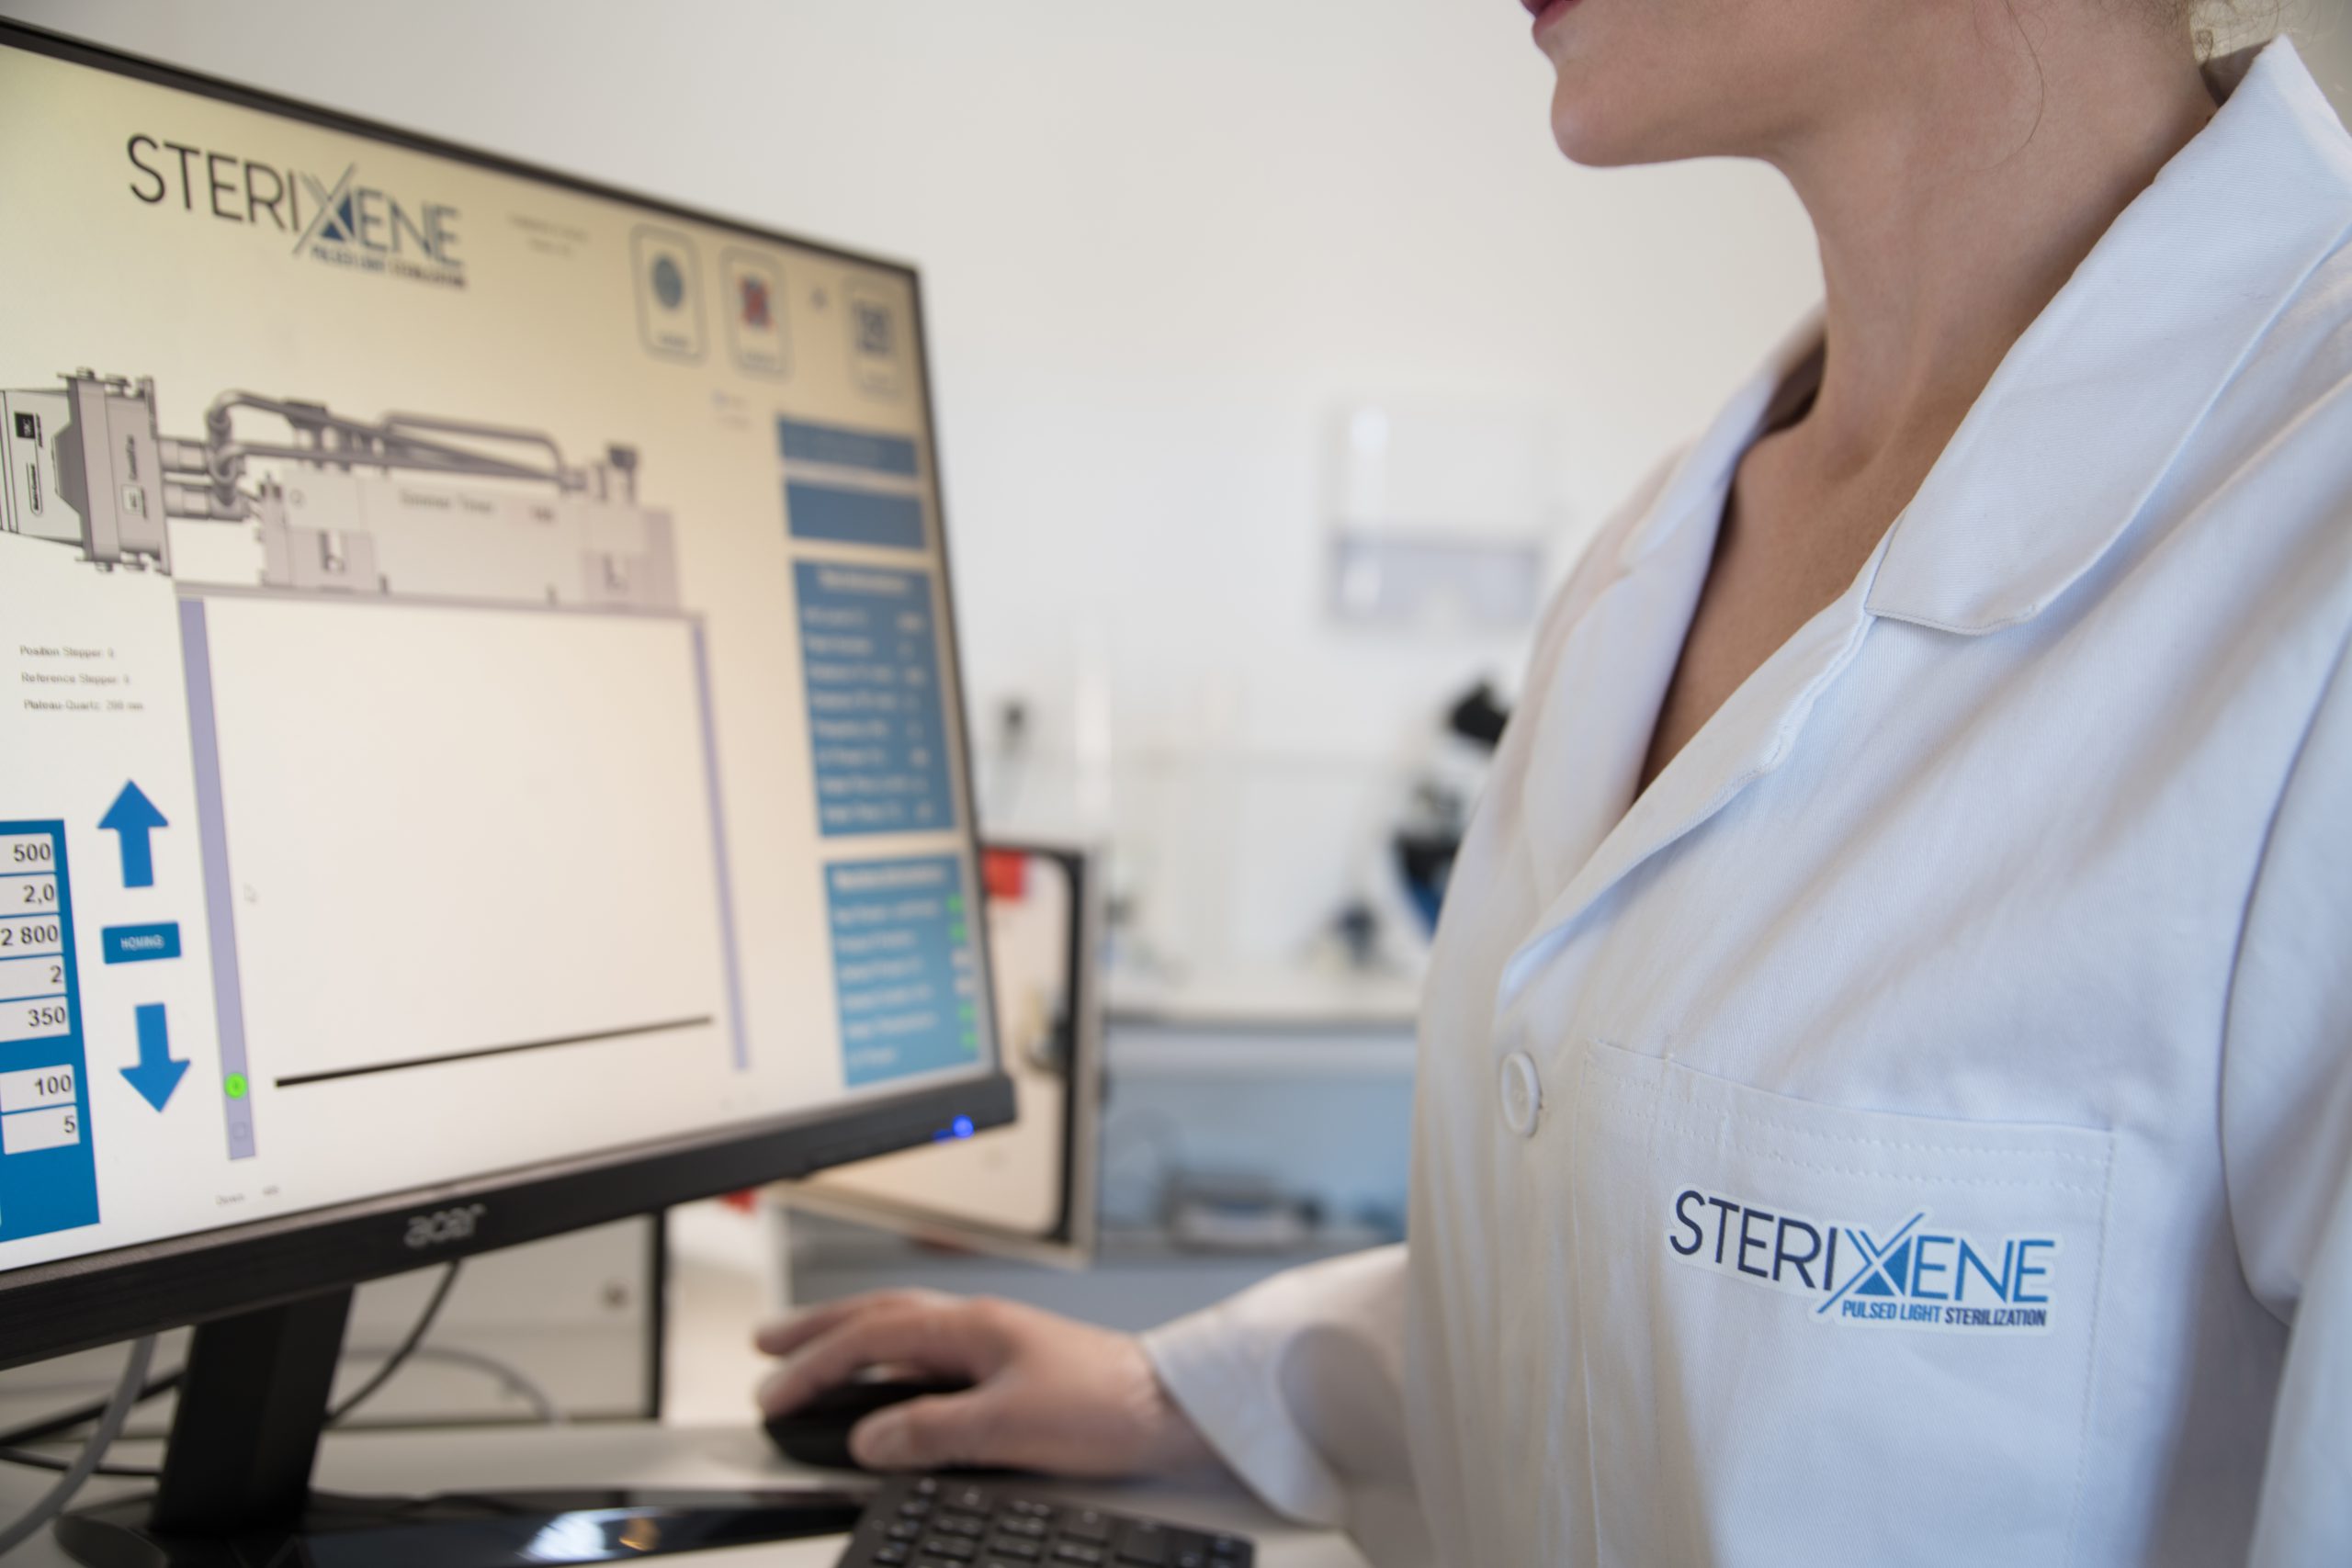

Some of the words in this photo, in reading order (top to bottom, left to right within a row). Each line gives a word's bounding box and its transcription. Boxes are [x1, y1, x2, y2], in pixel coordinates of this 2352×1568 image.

[126, 132, 464, 267] STERIXENE
[19, 645, 60, 656] Position
[21, 671, 75, 683] Reference
[14, 843, 51, 862] 500
[23, 884, 55, 905] 2,0
[51, 964, 62, 983] 2
[28, 1006, 65, 1027] 350
[35, 1074, 72, 1095] 100
[64, 1115, 75, 1134] 5
[1669, 1190, 2055, 1314] STERIXENE
[1841, 1300, 1897, 1320] PULSED
[1899, 1304, 1941, 1324] LIGHT
[1944, 1307, 2047, 1327] STERILIZATION
